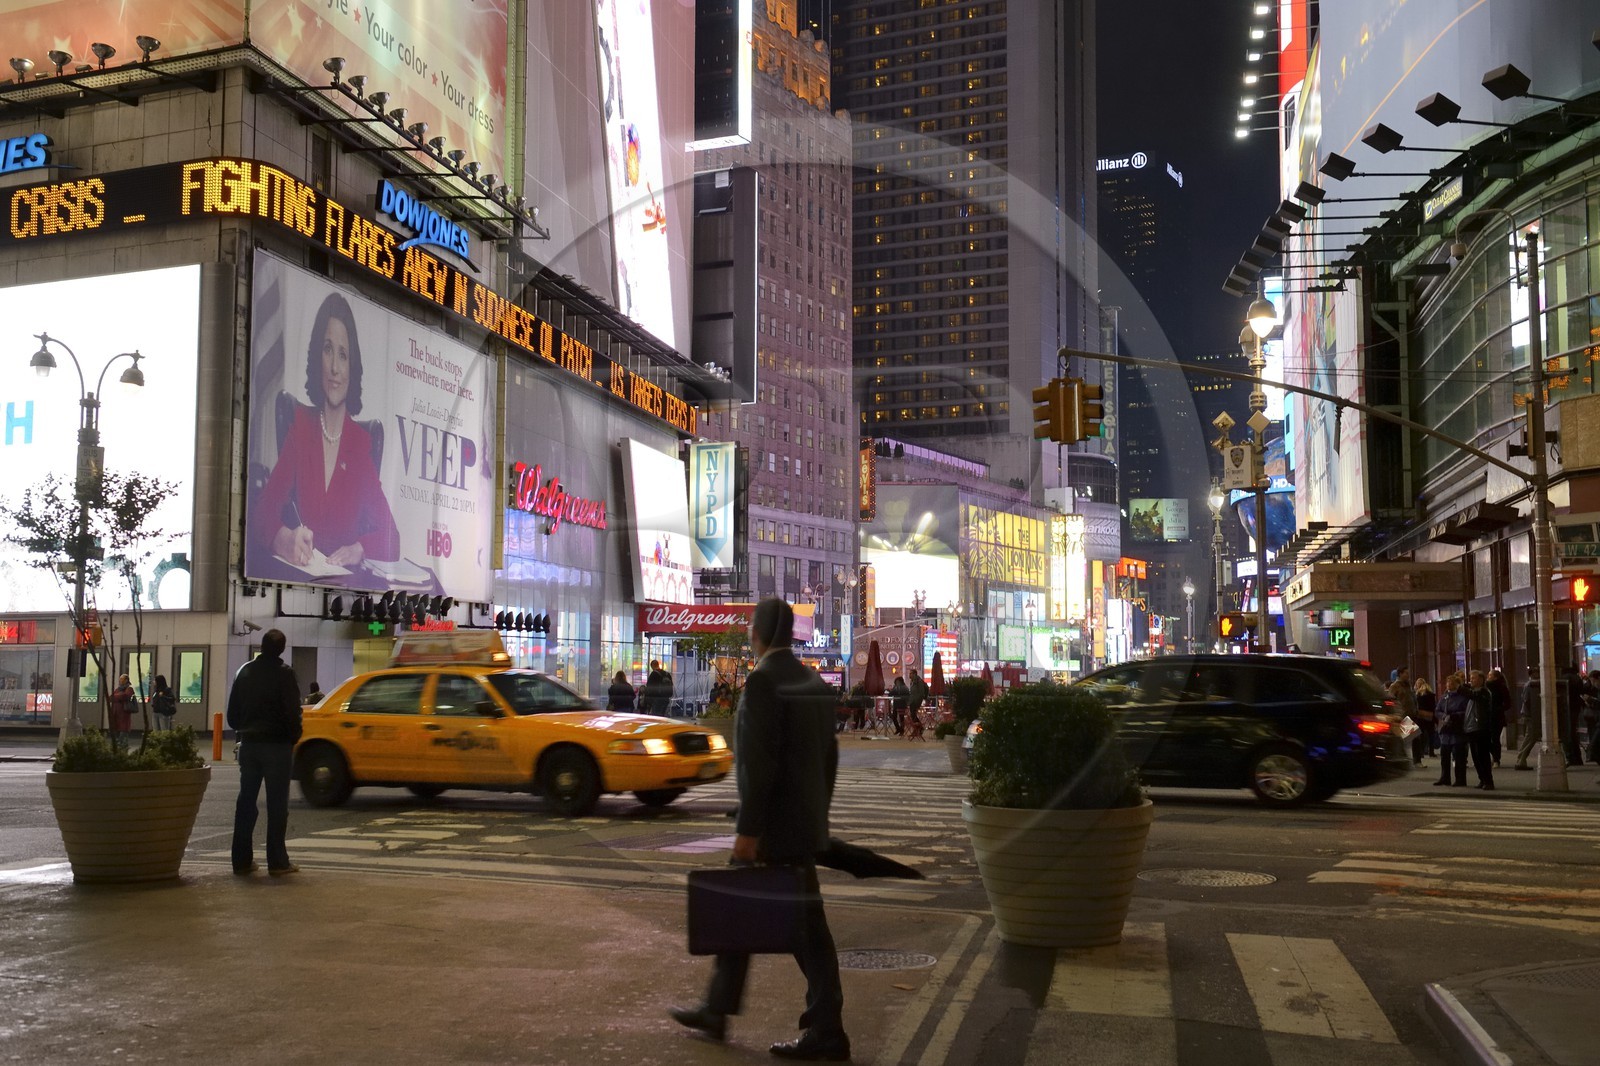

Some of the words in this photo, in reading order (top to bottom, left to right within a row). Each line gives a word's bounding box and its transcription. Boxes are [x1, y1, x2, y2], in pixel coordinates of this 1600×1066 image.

[365, 6, 395, 52] Your
[397, 45, 428, 79] color
[441, 70, 465, 110] Your
[468, 96, 494, 134] dress
[1096, 157, 1130, 171] llianz
[11, 178, 104, 238] CRISIS
[182, 160, 316, 237] FIGHTING
[325, 199, 395, 279] FLARES
[403, 246, 448, 305] ANEW
[453, 271, 468, 317] IN
[473, 283, 535, 352] SUDANESE
[540, 321, 556, 363] OIL
[561, 332, 592, 382] PATCH
[610, 361, 625, 398] U.S.
[629, 371, 662, 418] TARGETS
[409, 337, 424, 361] The
[425, 345, 443, 370] buck
[444, 360, 463, 381] stops
[395, 360, 439, 387] somewhere
[440, 379, 455, 394] near
[457, 380, 474, 401] here.
[411, 397, 426, 414] Julia
[426, 402, 463, 430] Louis-Dreyfus
[1103, 401, 1116, 460] SQUA
[84, 448, 98, 457] BUS
[395, 414, 477, 491] VEEP
[430, 492, 451, 509] APRIL
[451, 497, 459, 510] 22
[514, 461, 608, 535] Walgreens
[706, 450, 718, 537] NYPD
[426, 529, 453, 559] HBO
[1018, 528, 1029, 542] THE
[1567, 547, 1578, 555] W
[1584, 544, 1597, 556] 42
[1006, 543, 1023, 572] LION
[1023, 547, 1043, 575] KING
[1093, 587, 1103, 633] Kodak
